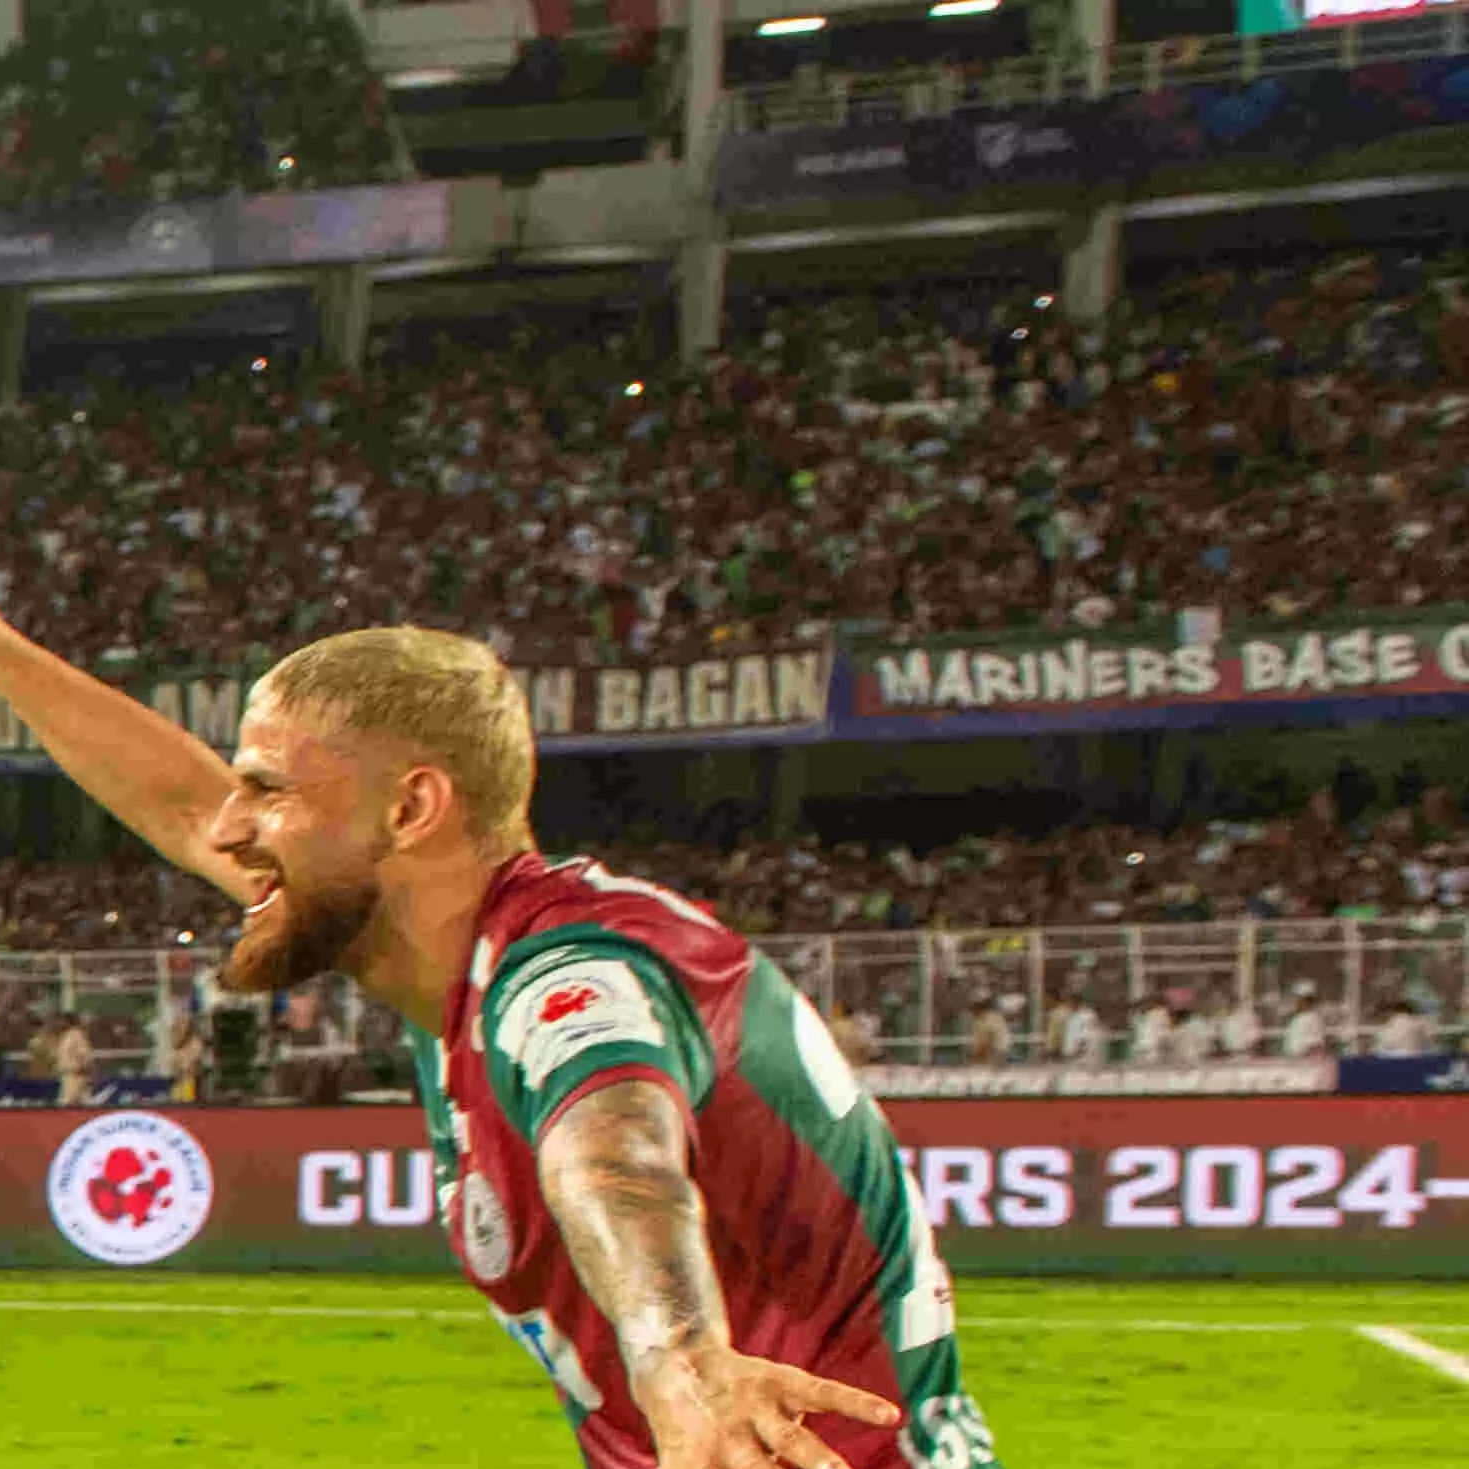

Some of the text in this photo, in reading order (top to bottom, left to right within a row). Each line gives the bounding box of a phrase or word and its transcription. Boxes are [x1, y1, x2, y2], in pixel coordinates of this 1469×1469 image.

[596, 652, 820, 732] BAGAN
[873, 639, 1221, 706] MARINERS
[1240, 629, 1422, 692] BASE
[299, 1150, 433, 1225] CU
